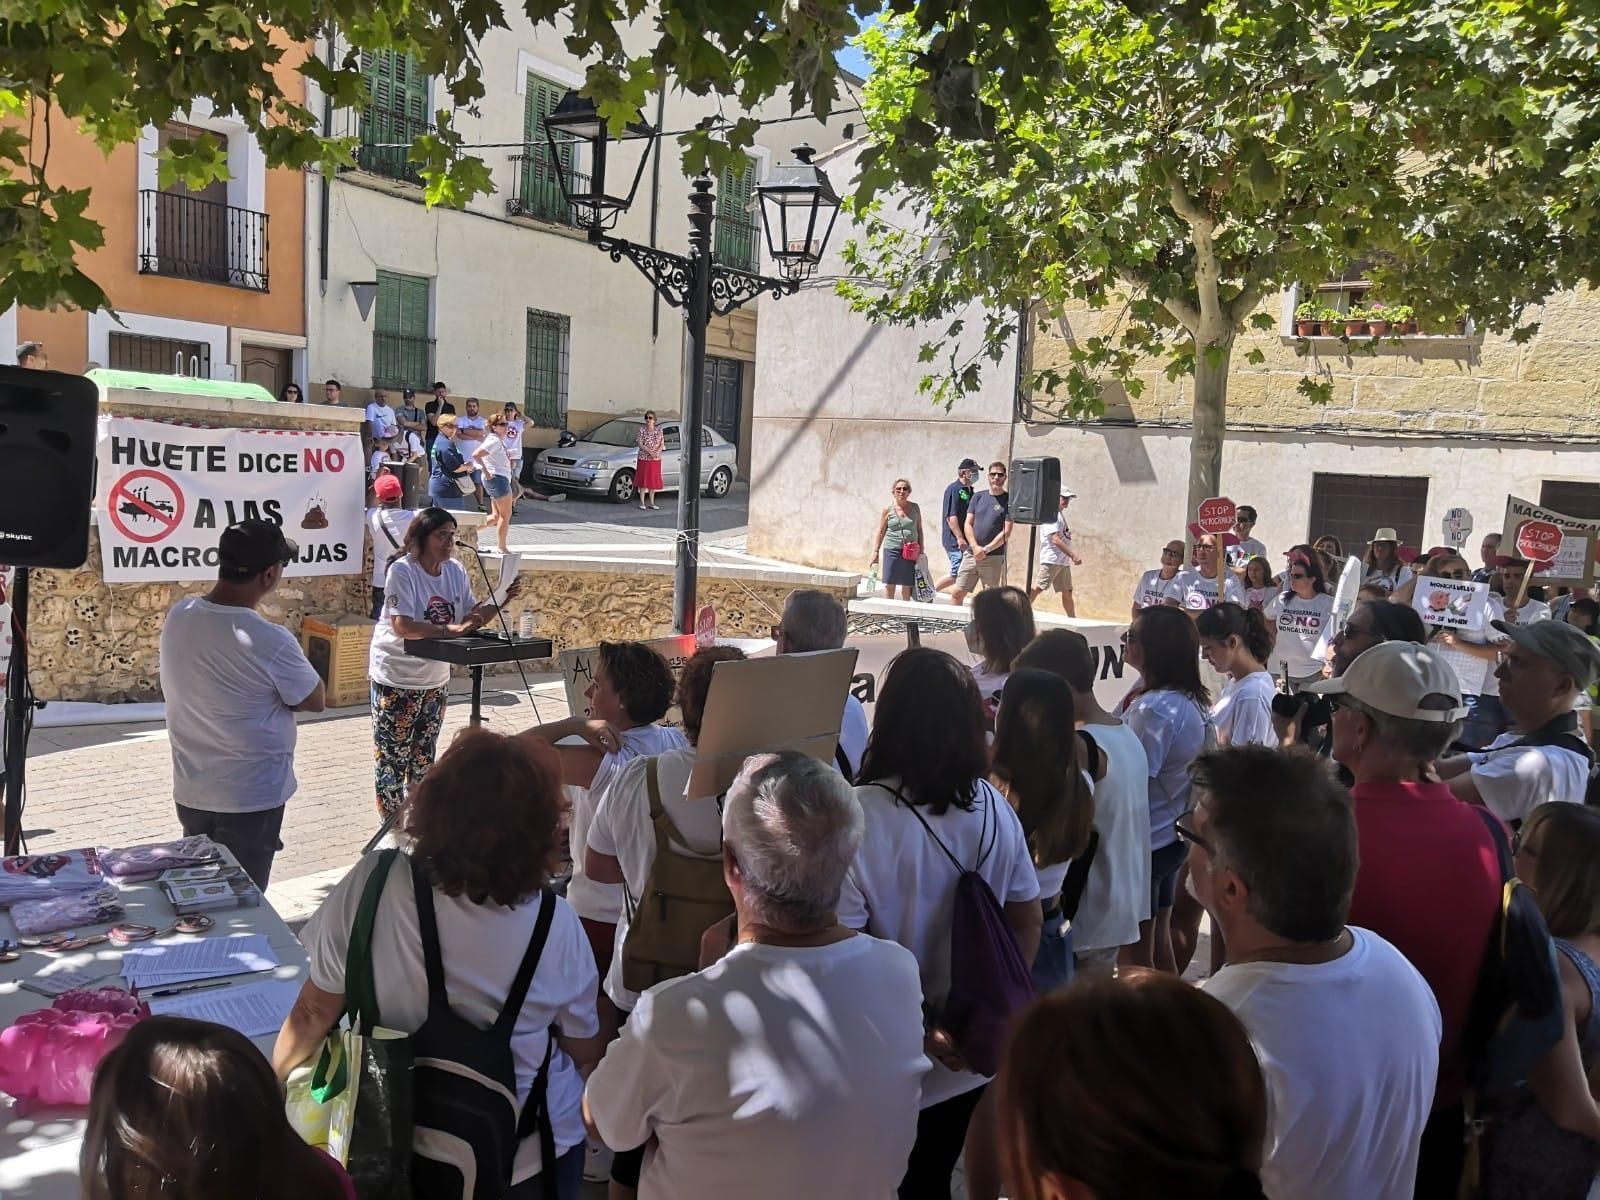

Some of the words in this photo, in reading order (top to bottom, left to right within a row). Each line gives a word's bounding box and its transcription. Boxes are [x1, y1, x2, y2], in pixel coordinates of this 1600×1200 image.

[111, 436, 227, 472] HUETE
[238, 454, 298, 473] DICE
[304, 448, 345, 473] NO
[193, 498, 216, 528] A
[1204, 505, 1229, 517] STOP
[1451, 509, 1461, 518] NO
[1451, 531, 1461, 541] NO
[1526, 528, 1555, 541] STOP
[1295, 616, 1320, 628] NO
[1279, 625, 1319, 635] MONCALVILLO
